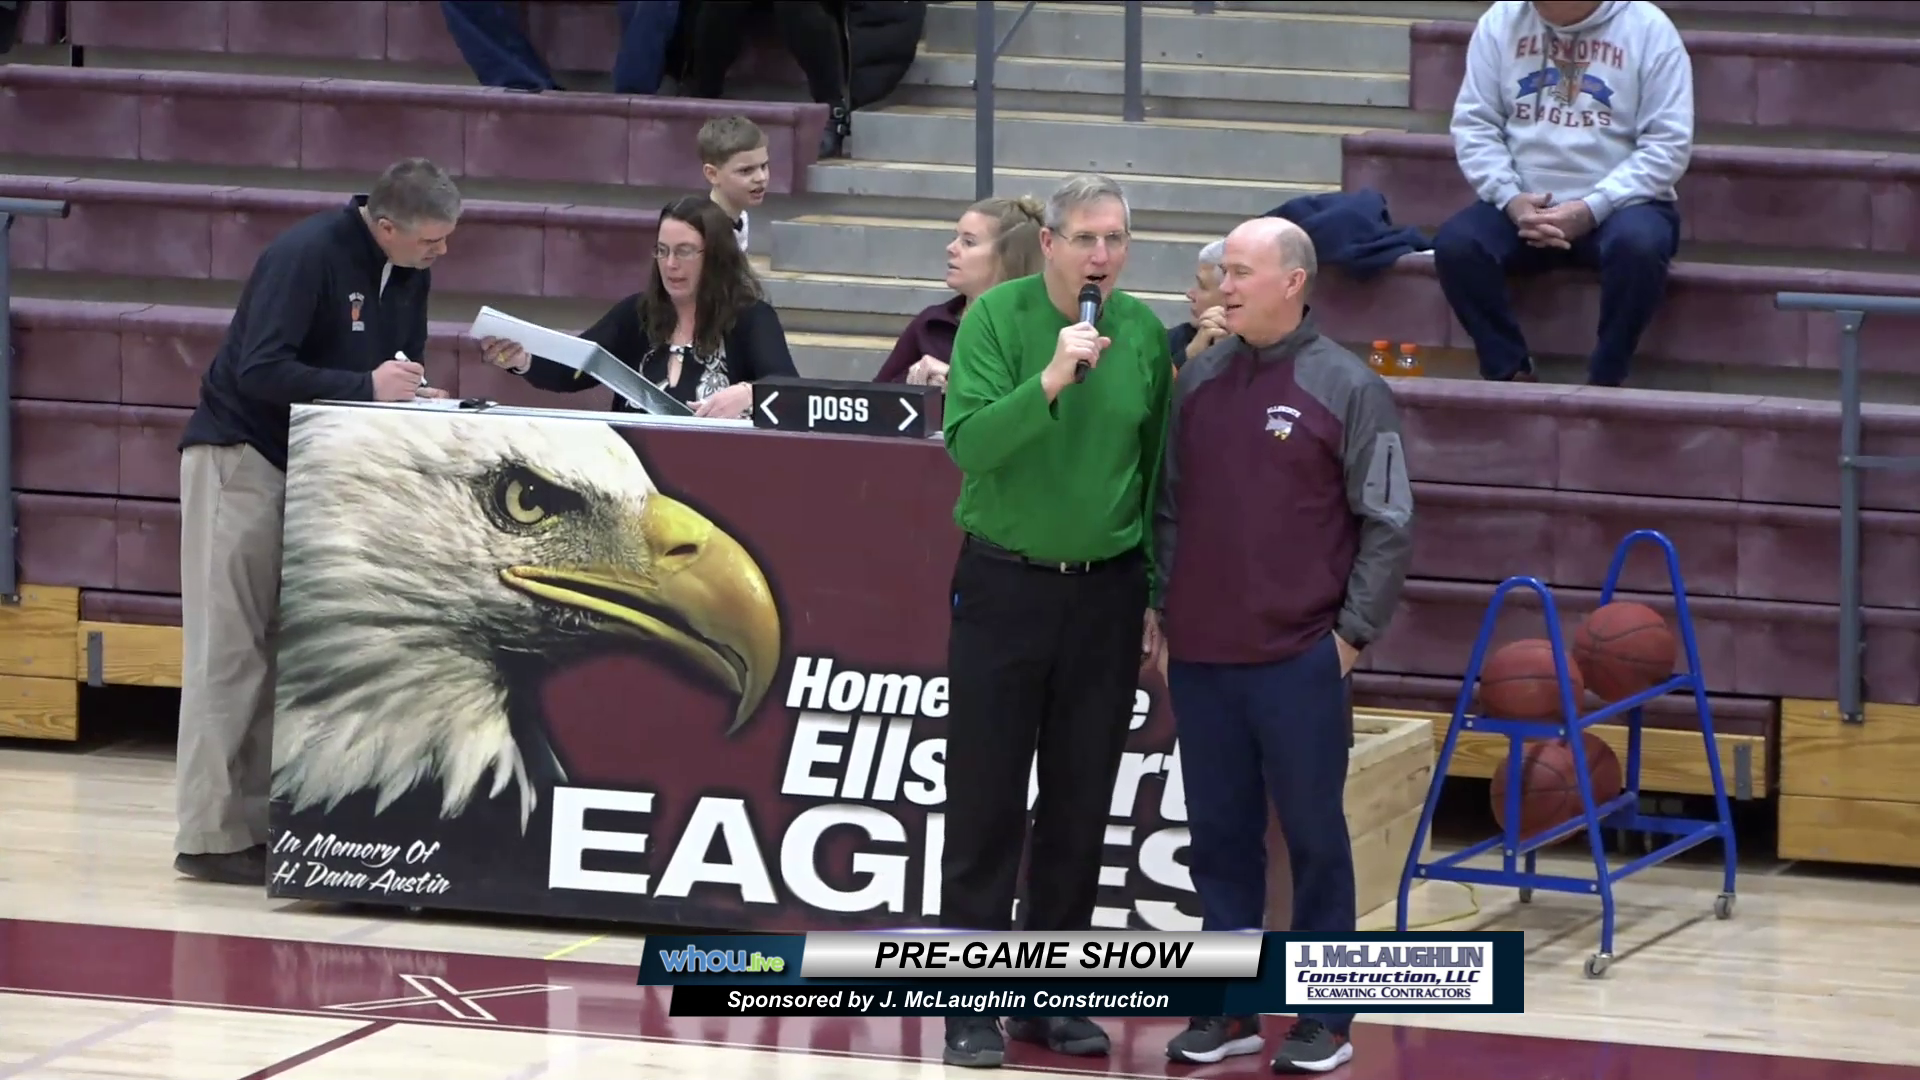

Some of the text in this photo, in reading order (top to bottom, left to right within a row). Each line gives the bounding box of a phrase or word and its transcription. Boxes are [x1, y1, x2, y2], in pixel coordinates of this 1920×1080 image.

[1516, 34, 1623, 70] ELSWORTH
[808, 395, 869, 427] poss
[786, 656, 949, 717] Home
[781, 712, 1188, 822] Ellsrt
[272, 830, 440, 868] In Memory Of
[272, 860, 451, 896] H. Dana Austin
